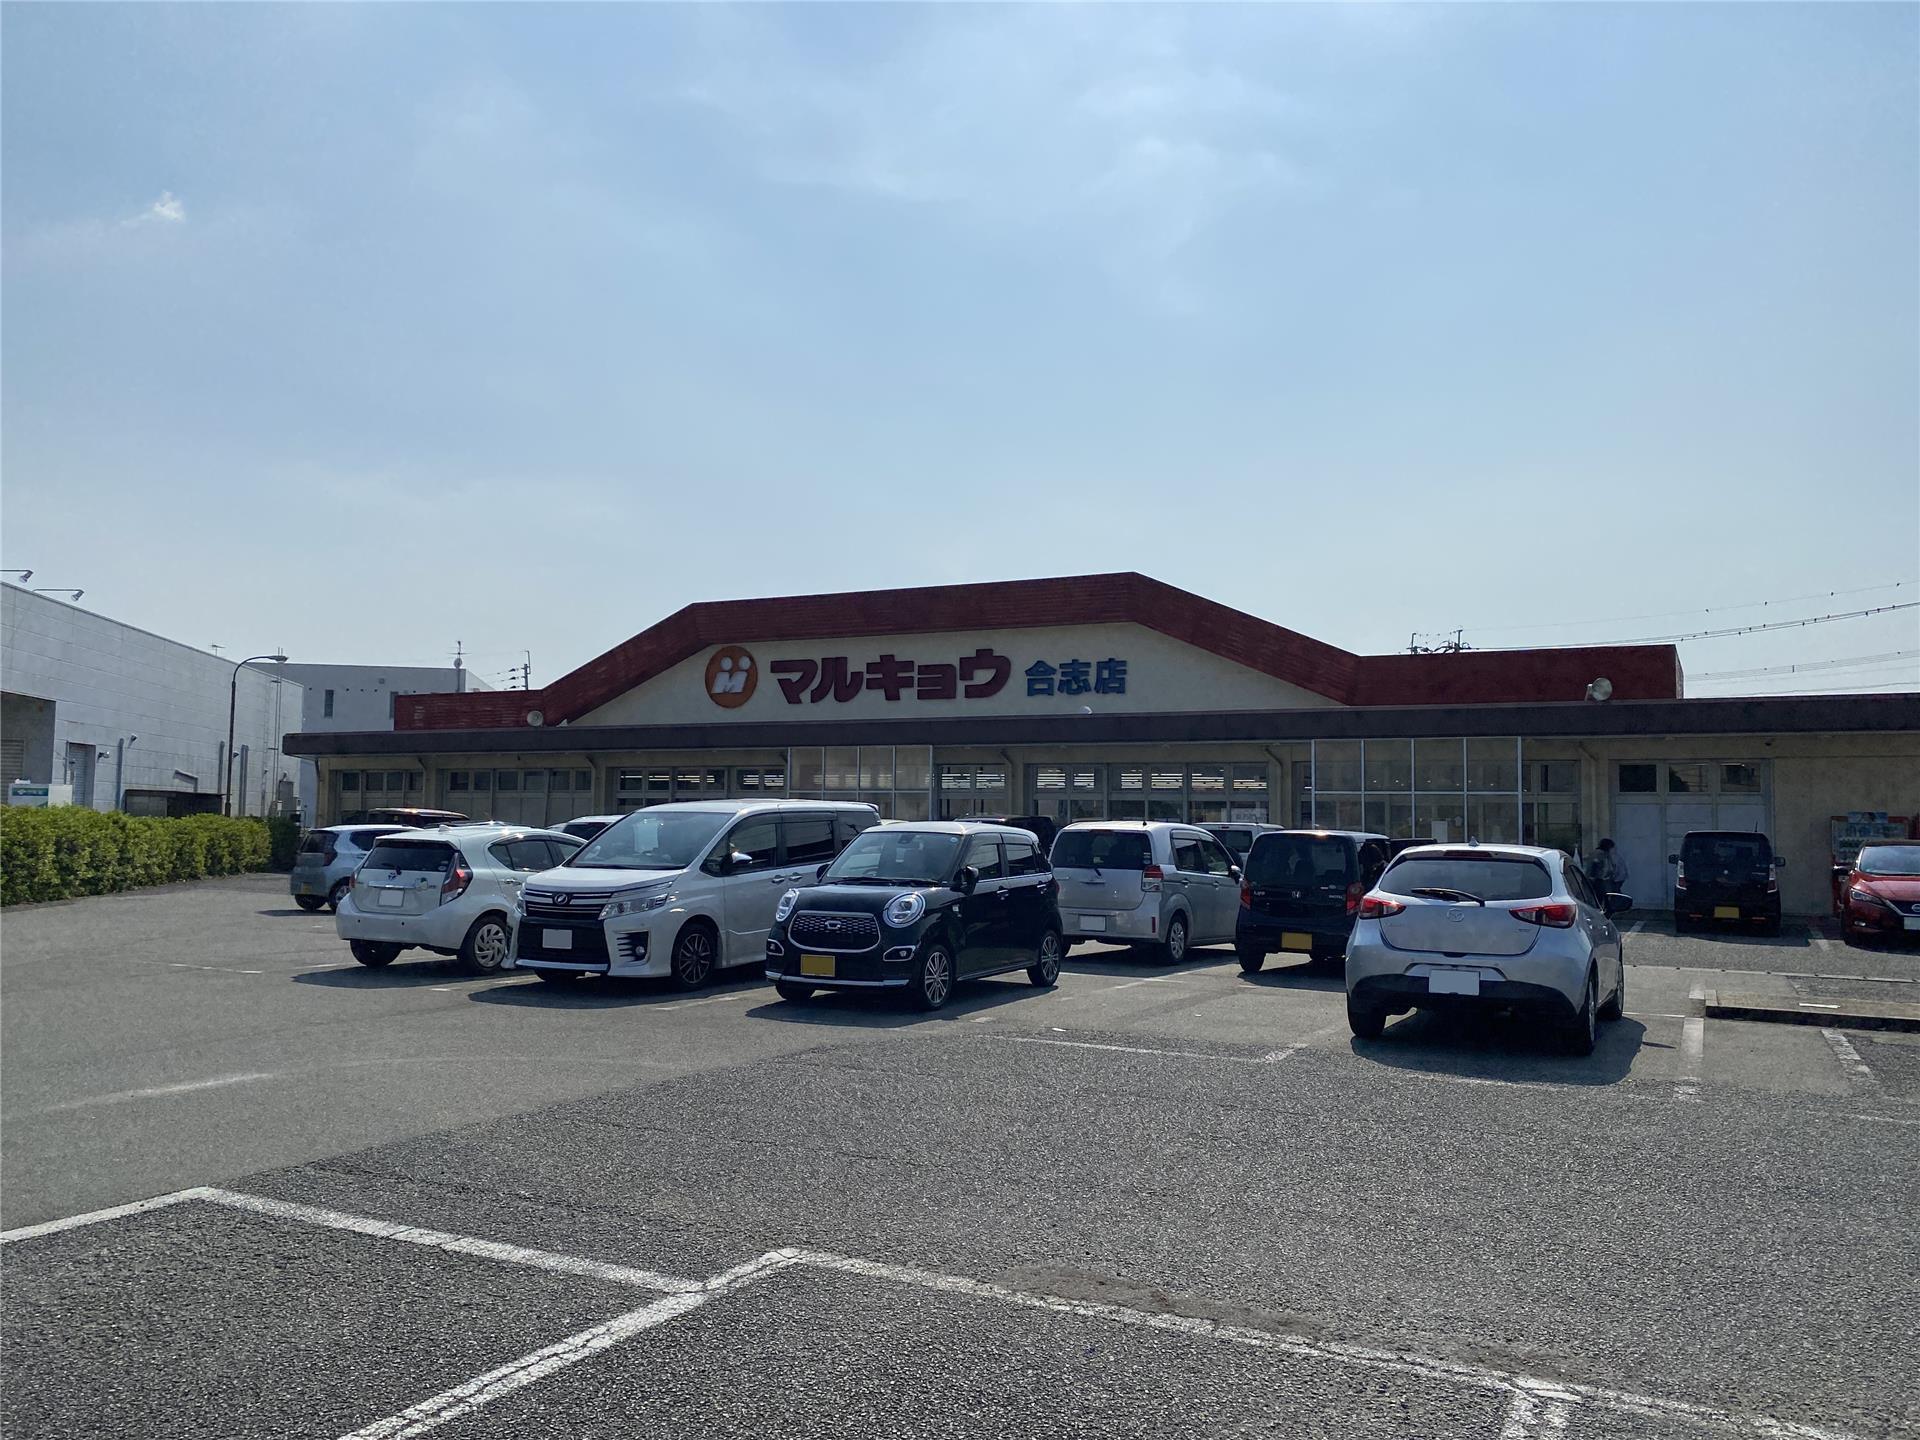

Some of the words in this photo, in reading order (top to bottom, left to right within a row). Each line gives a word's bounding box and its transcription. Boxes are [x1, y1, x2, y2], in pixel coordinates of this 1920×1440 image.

[770, 648, 1012, 704] マルキョウ
[1024, 657, 1127, 696] 合志店
